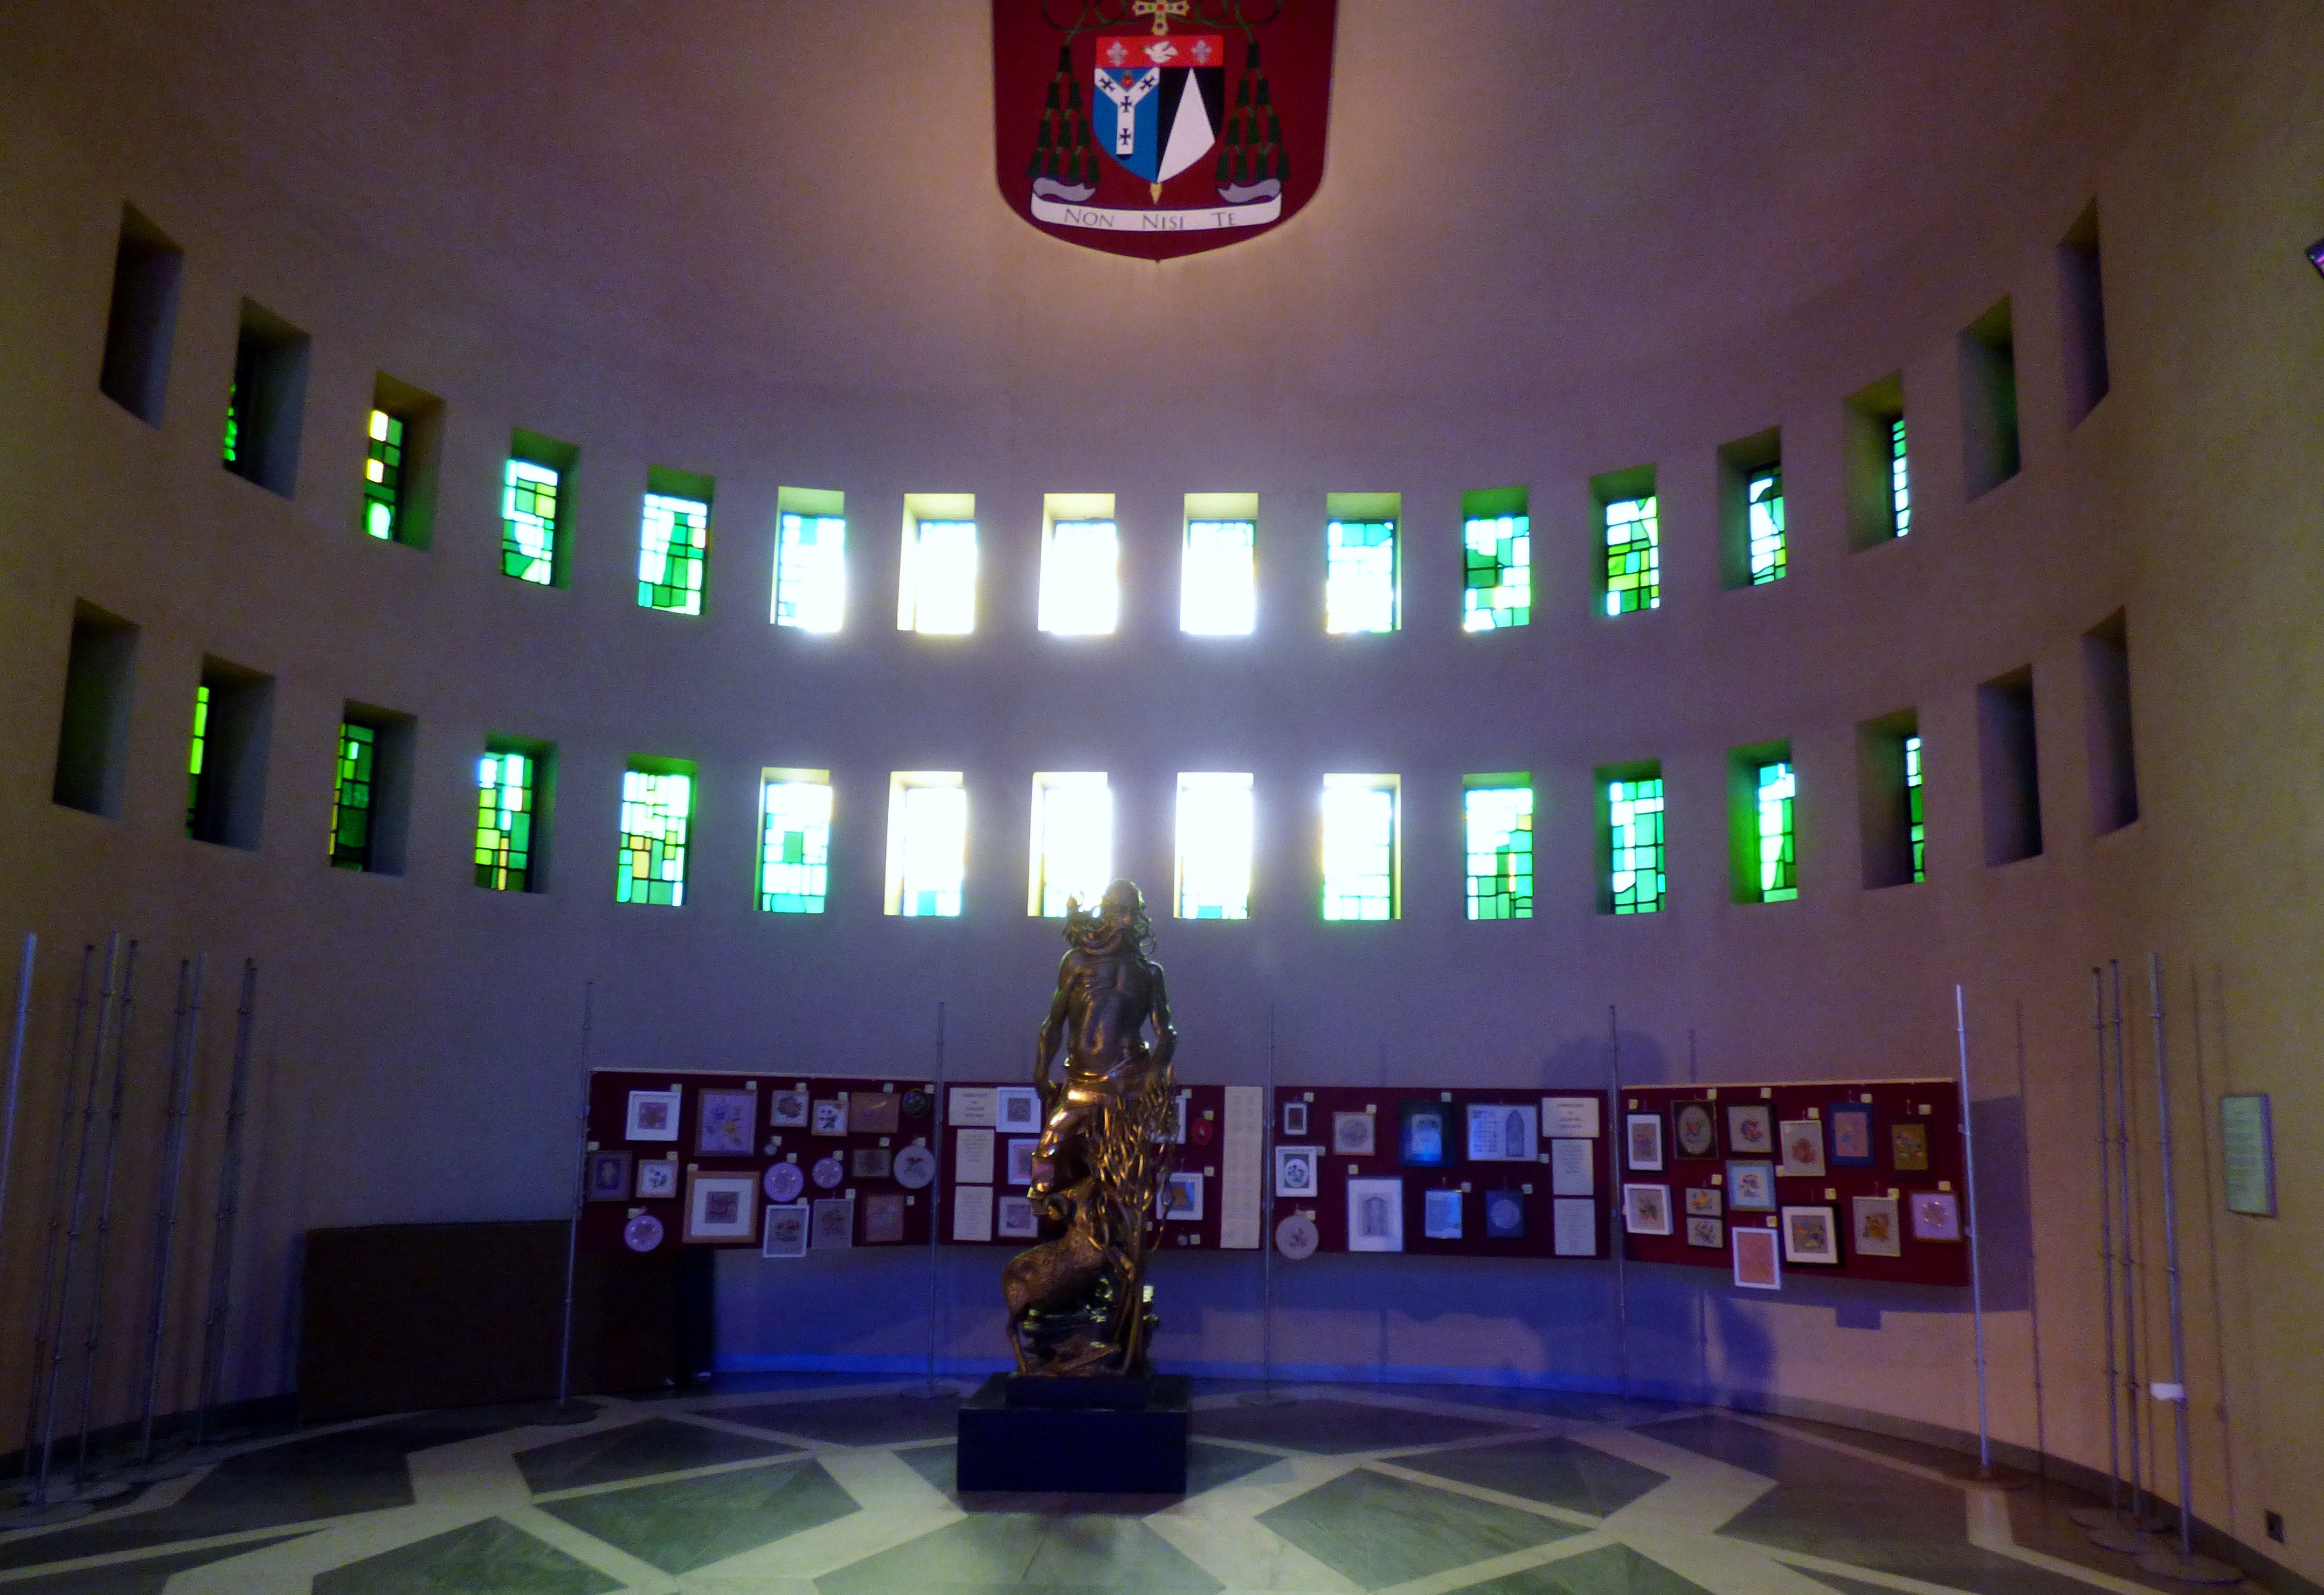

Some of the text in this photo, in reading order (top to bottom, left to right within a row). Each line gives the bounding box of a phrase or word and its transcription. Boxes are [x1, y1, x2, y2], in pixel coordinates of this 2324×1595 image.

[1064, 208, 1235, 230] NON NISI TE
